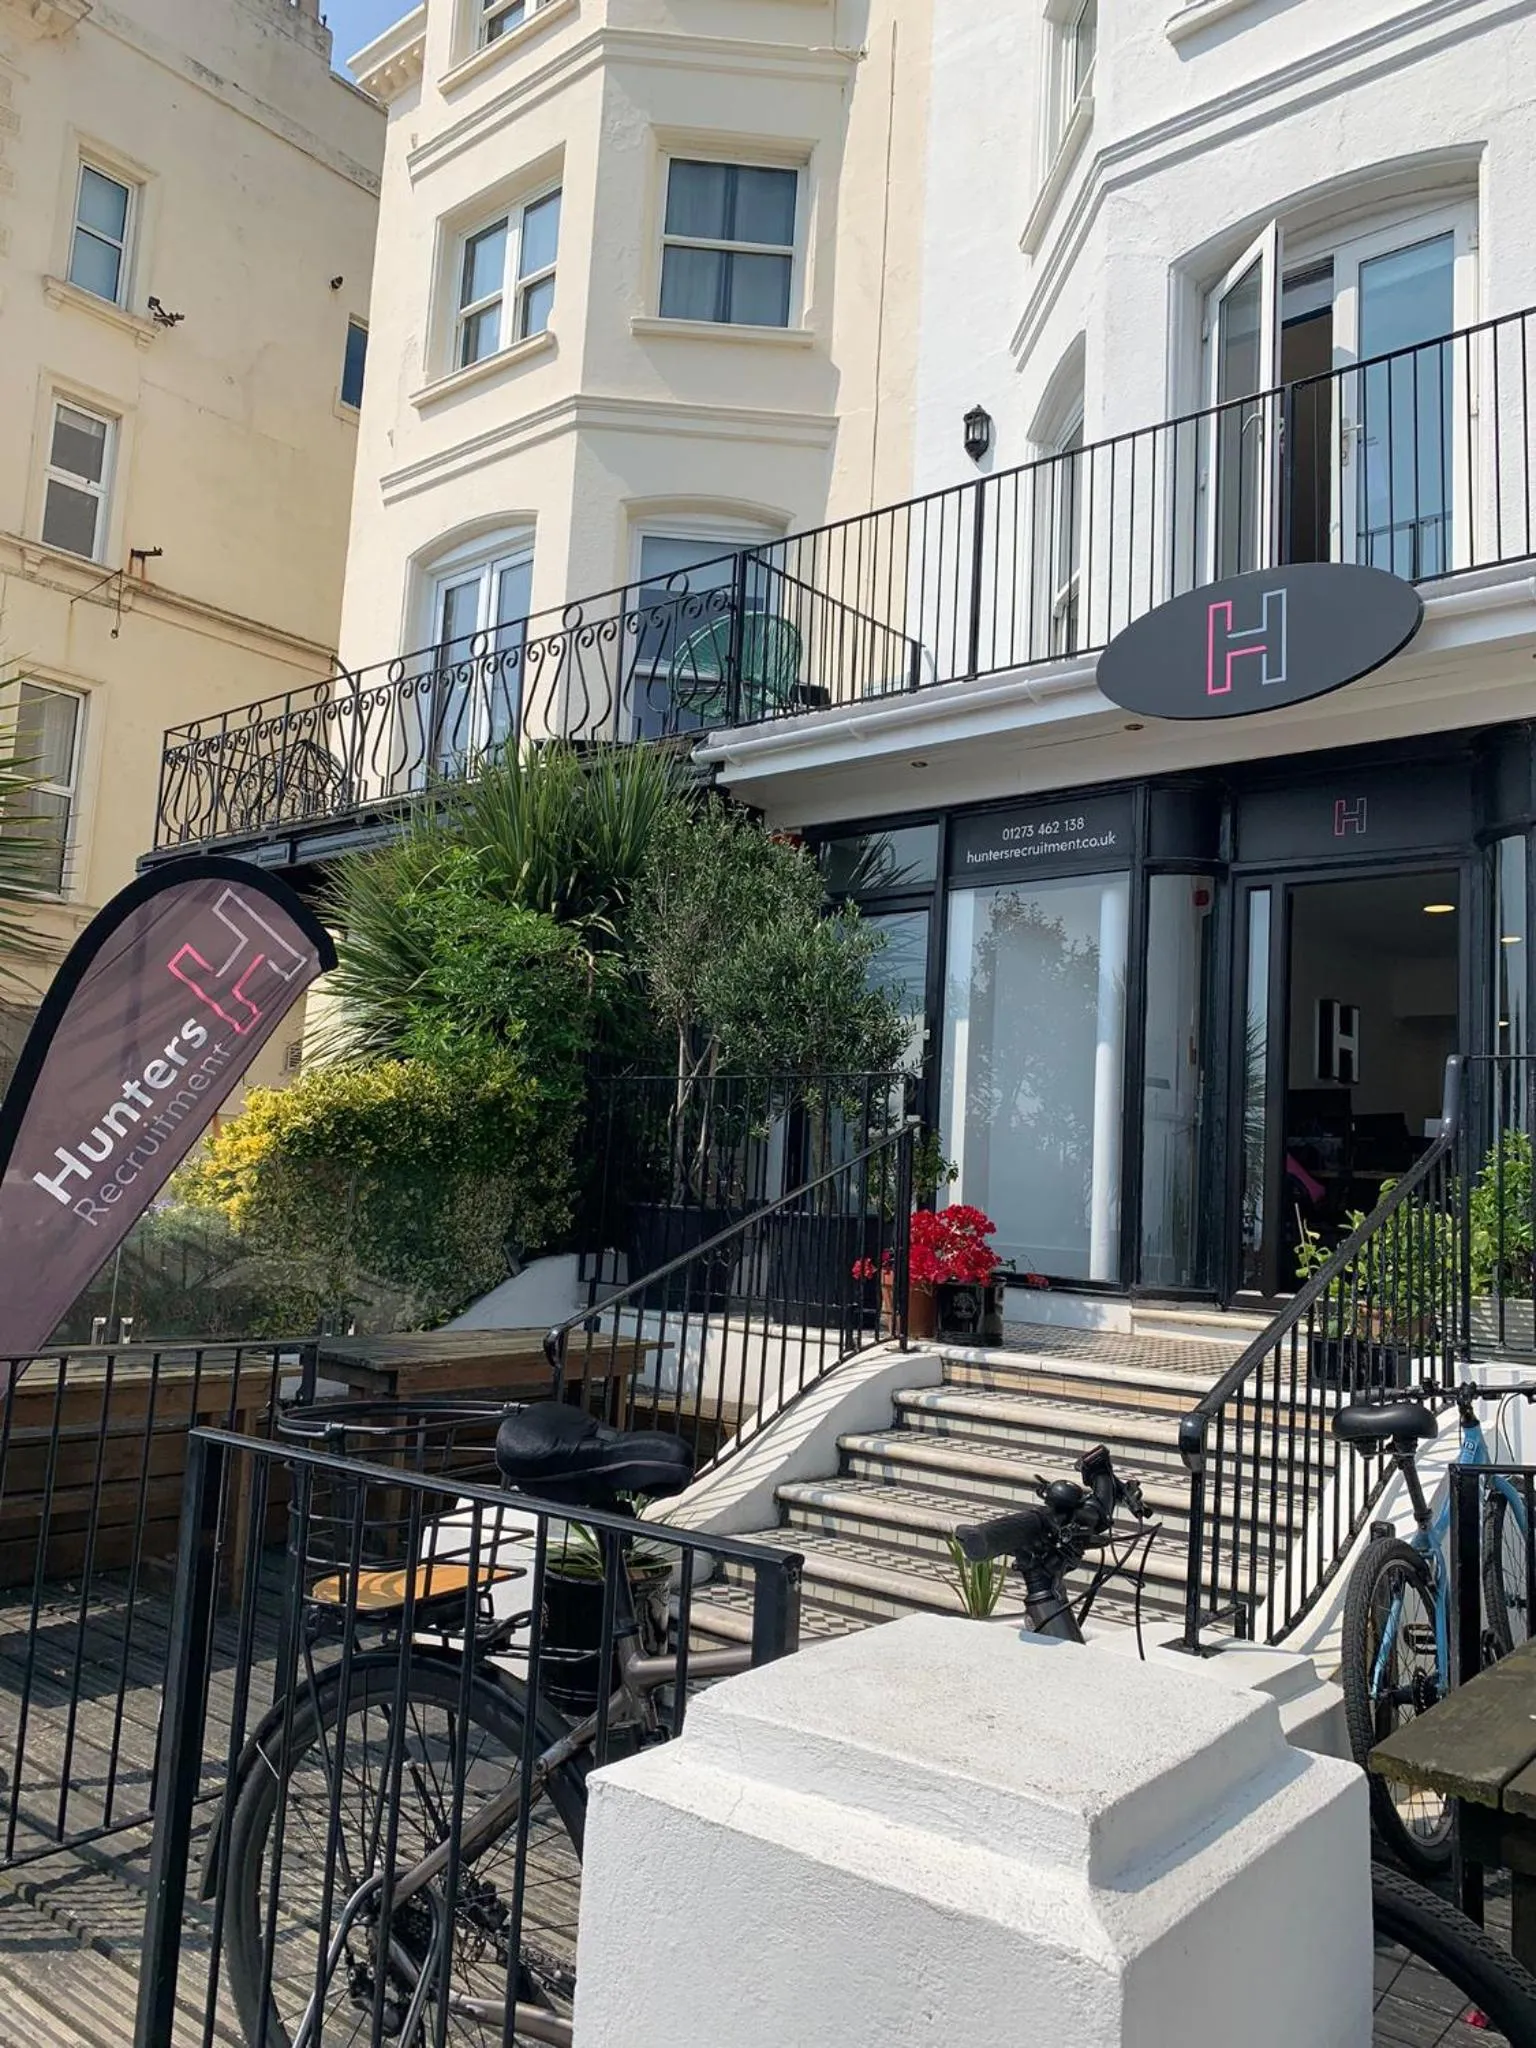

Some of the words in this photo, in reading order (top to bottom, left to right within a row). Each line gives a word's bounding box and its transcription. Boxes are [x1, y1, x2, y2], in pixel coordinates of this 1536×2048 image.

[1206, 587, 1287, 696] H
[966, 831, 1117, 863] huntersrecruitment.co.uk
[1002, 825, 1034, 841] 01273
[1038, 821, 1060, 835] 462
[1064, 817, 1085, 831] 138
[1333, 796, 1367, 836] H
[33, 1018, 209, 1205] Hunters
[72, 1042, 232, 1226] Recruitment
